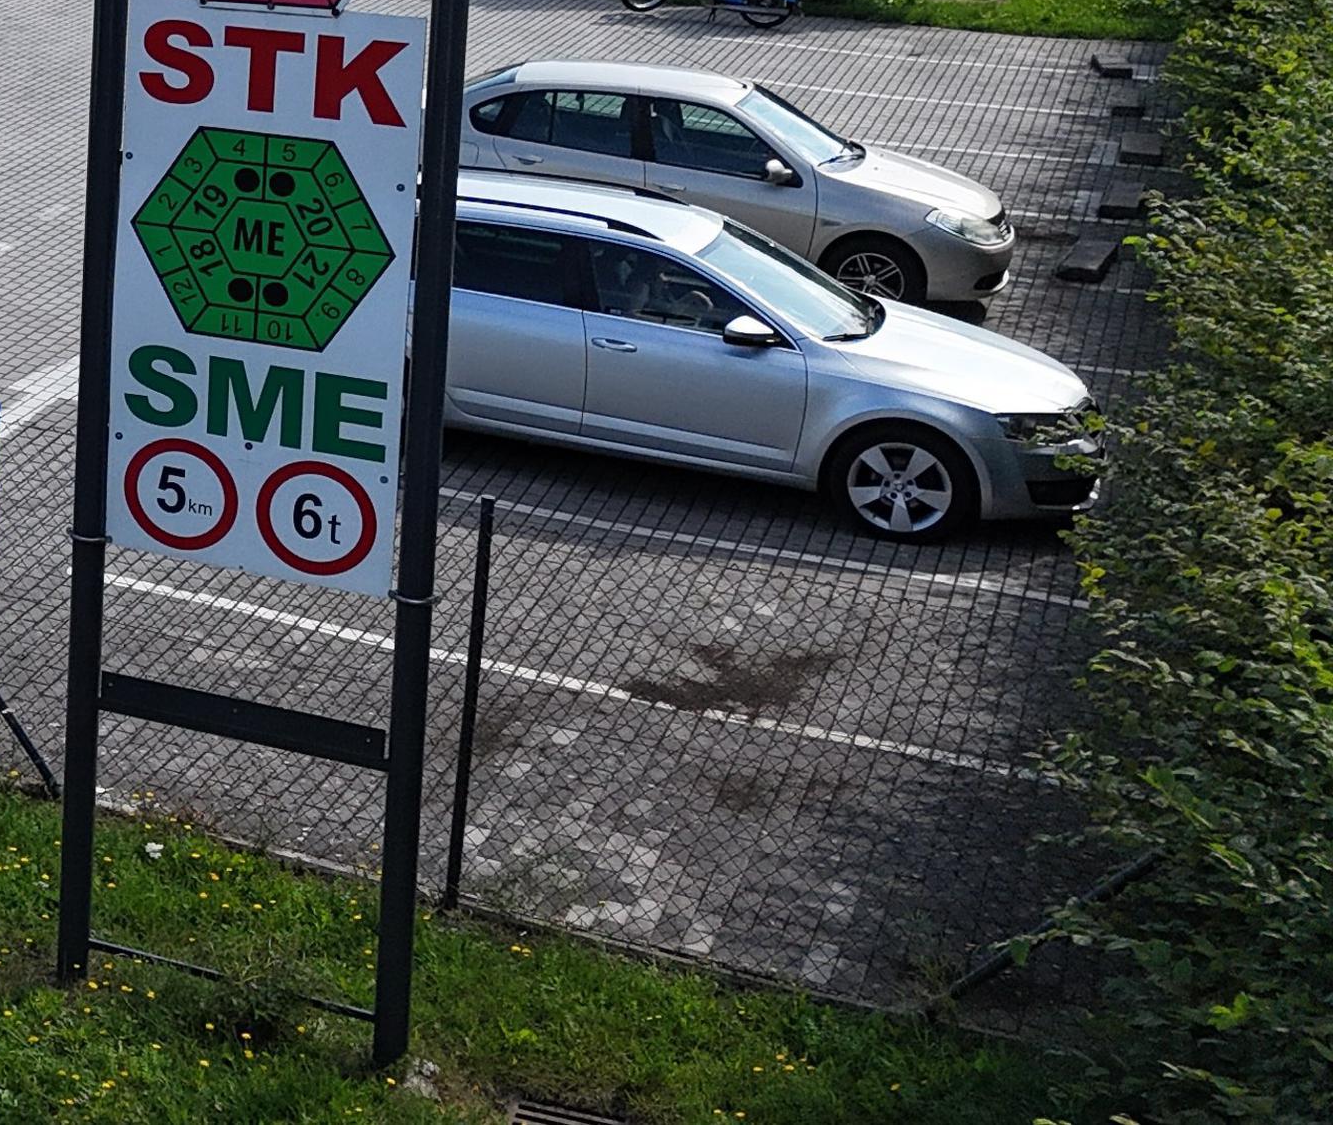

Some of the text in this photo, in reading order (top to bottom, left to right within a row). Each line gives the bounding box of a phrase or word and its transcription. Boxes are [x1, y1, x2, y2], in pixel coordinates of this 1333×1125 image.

[139, 19, 410, 128] STK
[233, 139, 246, 156] 4
[283, 143, 296, 162] 5
[184, 156, 203, 174] 3
[158, 192, 179, 211] 2
[193, 184, 228, 220] 19
[296, 197, 333, 237] 20
[351, 218, 372, 235] 7
[233, 217, 286, 257] ME
[156, 244, 172, 257] 1
[190, 239, 224, 277] 18
[293, 251, 330, 290] 21
[346, 268, 366, 286] 8
[173, 279, 198, 305] 12
[221, 314, 243, 333] 11
[267, 320, 293, 341] 10
[124, 345, 388, 463] SME
